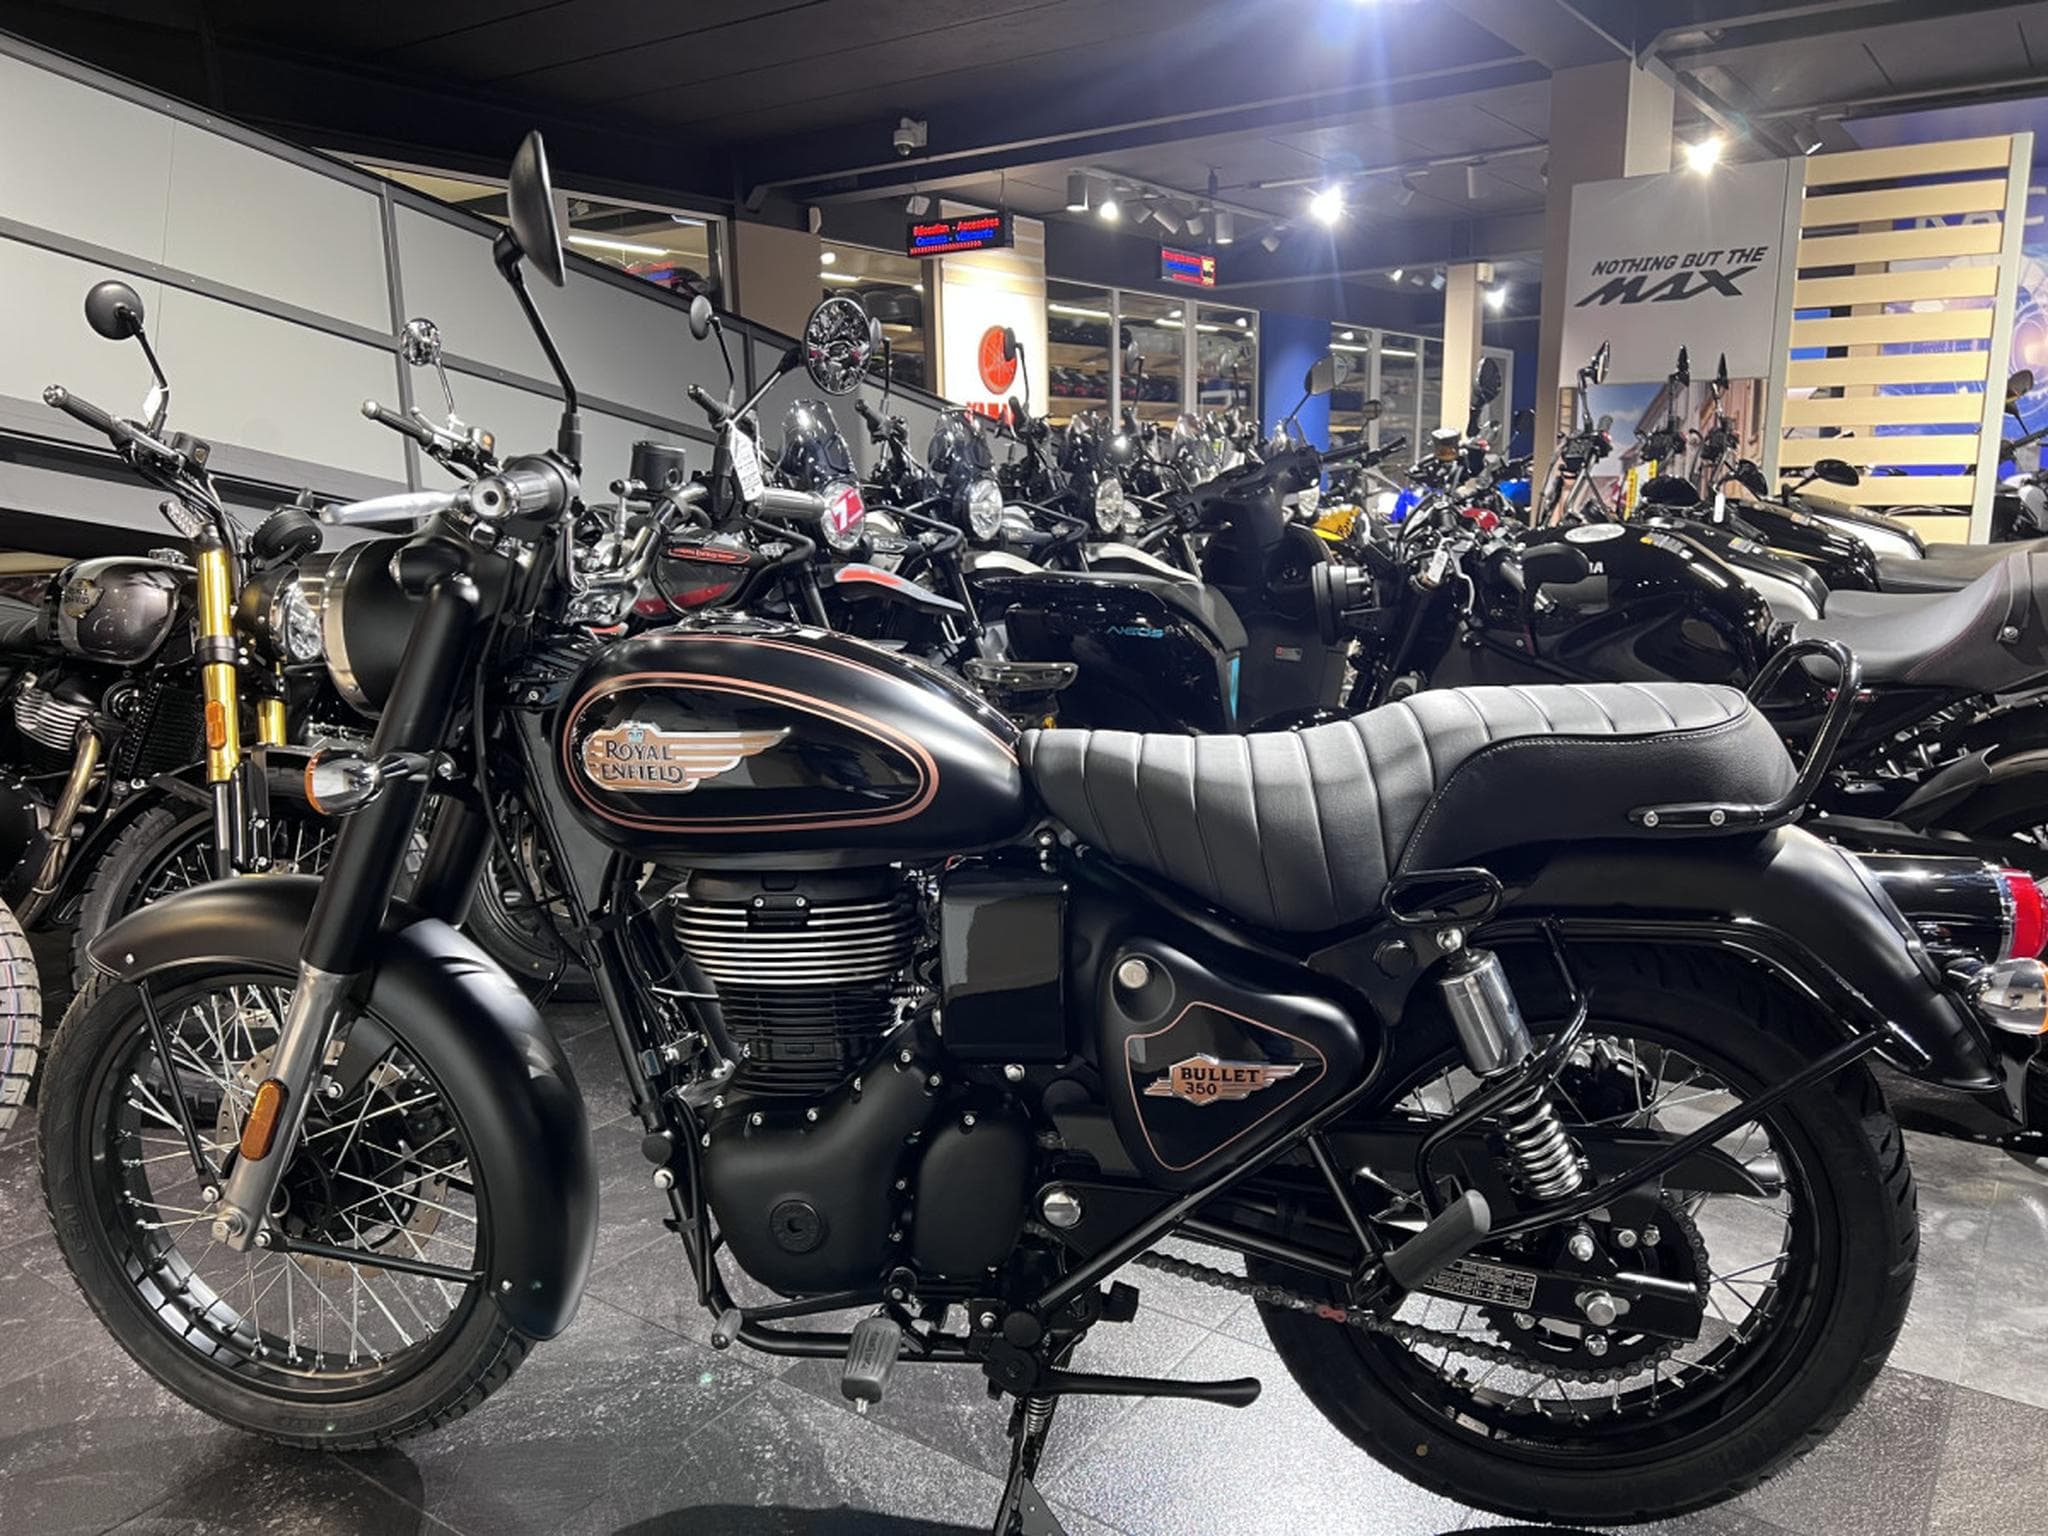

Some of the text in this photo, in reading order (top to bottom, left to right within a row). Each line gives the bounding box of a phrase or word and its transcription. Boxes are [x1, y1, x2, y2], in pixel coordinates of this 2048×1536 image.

[1591, 245, 1769, 276] NOTHING BUT THE
[1574, 265, 1758, 308] MAX
[605, 740, 673, 761] ROYAL
[601, 763, 684, 783] ENFIELD
[1181, 1067, 1260, 1082] BULLET
[1185, 1082, 1217, 1095] 350
